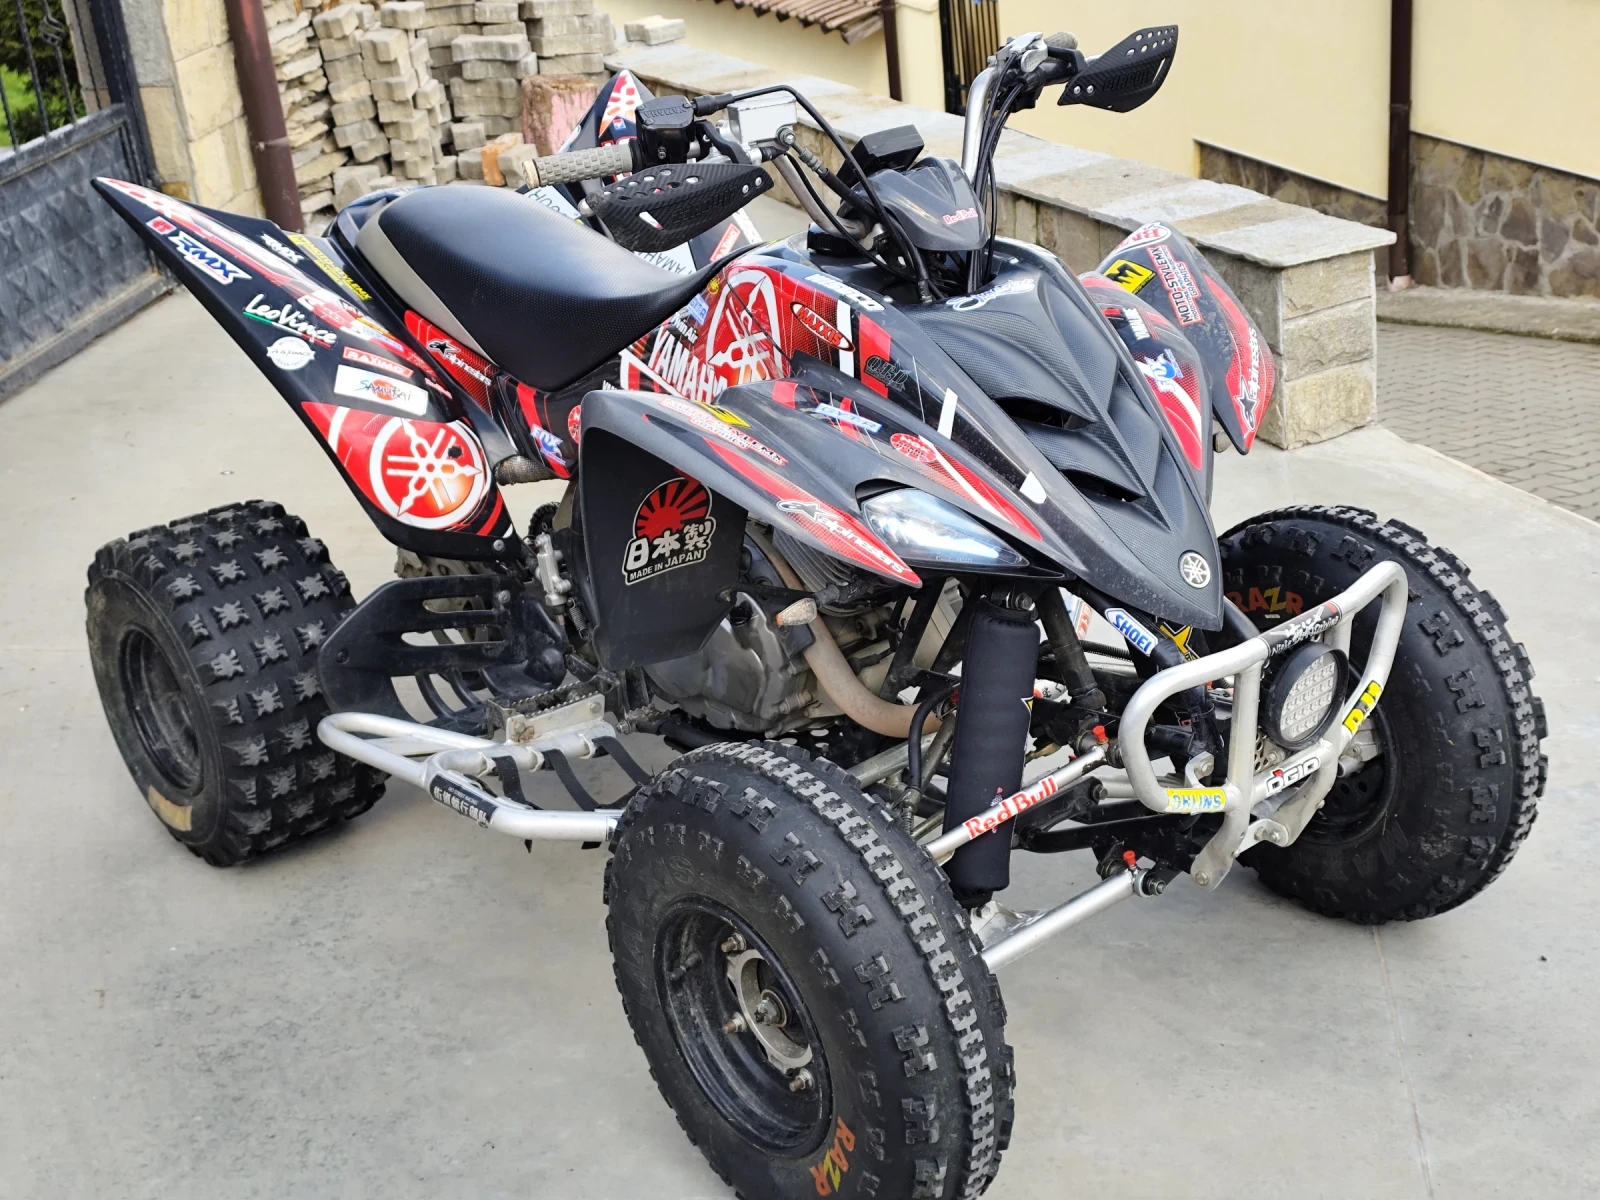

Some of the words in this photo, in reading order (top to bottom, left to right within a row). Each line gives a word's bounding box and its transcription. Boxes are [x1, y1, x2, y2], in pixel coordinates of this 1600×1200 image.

[1151, 246, 1193, 323] MOTO-STYLEMX
[244, 293, 337, 344] LeoVince
[795, 307, 844, 346] MAXXIS
[629, 566, 653, 581] MADE
[654, 561, 663, 572] IN
[664, 550, 702, 569] JAPAN
[1225, 586, 1305, 616] RAZR
[1111, 613, 1153, 653] SHOEI
[963, 800, 1012, 839] Red
[1011, 775, 1059, 814] Bull
[808, 1115, 857, 1198] RAZR
